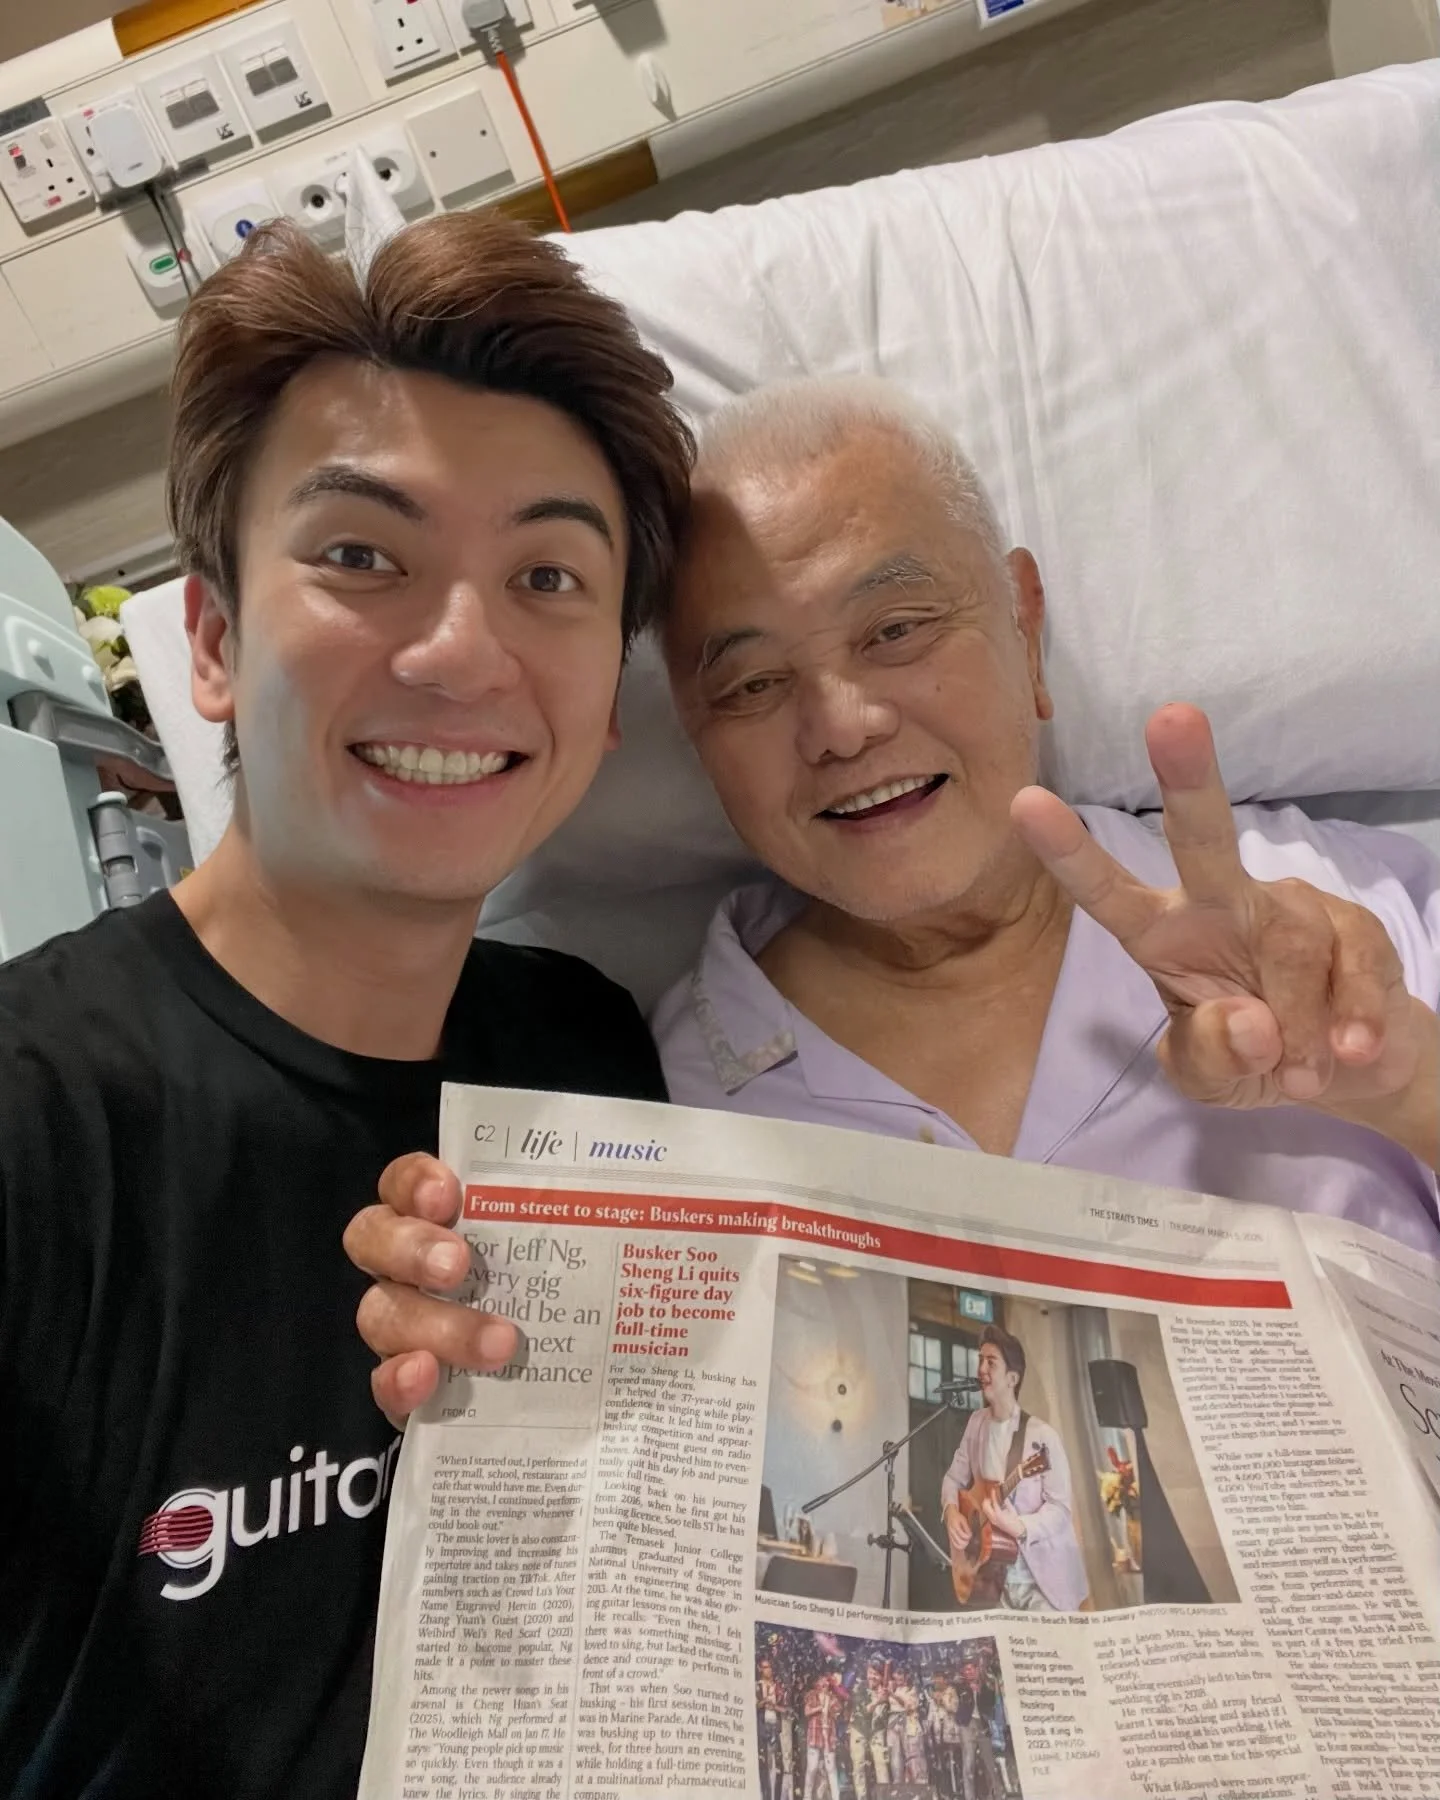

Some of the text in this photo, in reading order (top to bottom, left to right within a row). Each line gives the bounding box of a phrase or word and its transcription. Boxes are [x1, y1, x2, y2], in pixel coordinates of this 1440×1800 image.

[474, 1125, 667, 1161] C2 life music
[470, 1196, 881, 1248] From street to stage: Buskers making breakthroughs
[1090, 1208, 1105, 1219] THE
[1106, 1211, 1135, 1224] STRAITS
[1137, 1216, 1158, 1227] TIMES
[1169, 1222, 1204, 1234] THURSDAY
[506, 1237, 547, 1264] Jeff
[550, 1239, 586, 1270] Ng,
[624, 1244, 717, 1262] Busker Soo
[621, 1263, 739, 1284] Sheng Li quits
[525, 1270, 562, 1299] gig
[619, 1283, 732, 1304] six-figure day
[539, 1301, 566, 1323] be
[573, 1309, 600, 1324] an
[617, 1302, 735, 1320] job to become
[615, 1322, 688, 1338] full-time
[526, 1337, 576, 1352] next
[612, 1341, 688, 1356] musician
[608, 1377, 695, 1391] opened many doors.
[609, 1365, 757, 1387] For Soo Sheng Li, busking has
[627, 1388, 656, 1400] helped
[662, 1391, 676, 1400] the
[681, 1393, 731, 1408] 37-year-old
[736, 1401, 755, 1411] gain
[469, 1456, 473, 1465] I
[474, 1456, 505, 1465] started
[526, 1457, 530, 1466] I
[532, 1456, 578, 1469] performed
[436, 1533, 454, 1543] The
[457, 1534, 484, 1543] music
[487, 1535, 509, 1544] lover
[512, 1536, 519, 1544] is
[522, 1535, 539, 1544] also
[600, 1531, 743, 1562] The Temasek Junior College
[423, 1574, 458, 1585] gaining
[463, 1574, 499, 1584] traction
[503, 1576, 515, 1584] on
[554, 1573, 576, 1582] After
[588, 1557, 742, 1587] National University of Singapore
[422, 1588, 463, 1597] numbers
[467, 1588, 489, 1597] such
[491, 1590, 500, 1598] as
[506, 1587, 533, 1597] Crowd
[556, 1587, 575, 1595] Your
[755, 1595, 789, 1608] Musician
[792, 1602, 807, 1610] Soo
[810, 1603, 834, 1616] Sheng
[837, 1608, 844, 1616] Li
[847, 1610, 893, 1624] performing
[1041, 1616, 1066, 1624] Beach
[1069, 1616, 1088, 1624] Road
[1009, 1636, 1024, 1645] Soo
[1014, 1663, 1073, 1672] wearing green
[420, 1684, 569, 1696] Among the newer songs in his
[590, 1683, 743, 1705] That was when Soo turned to
[1018, 1688, 1086, 1698] champion in the
[1021, 1701, 1054, 1711] busking
[1202, 1699, 1218, 1709] old
[1251, 1695, 1281, 1705] friend
[452, 1714, 481, 1724] which
[489, 1714, 501, 1726] Ng
[508, 1714, 553, 1727] performed
[559, 1715, 567, 1723] at
